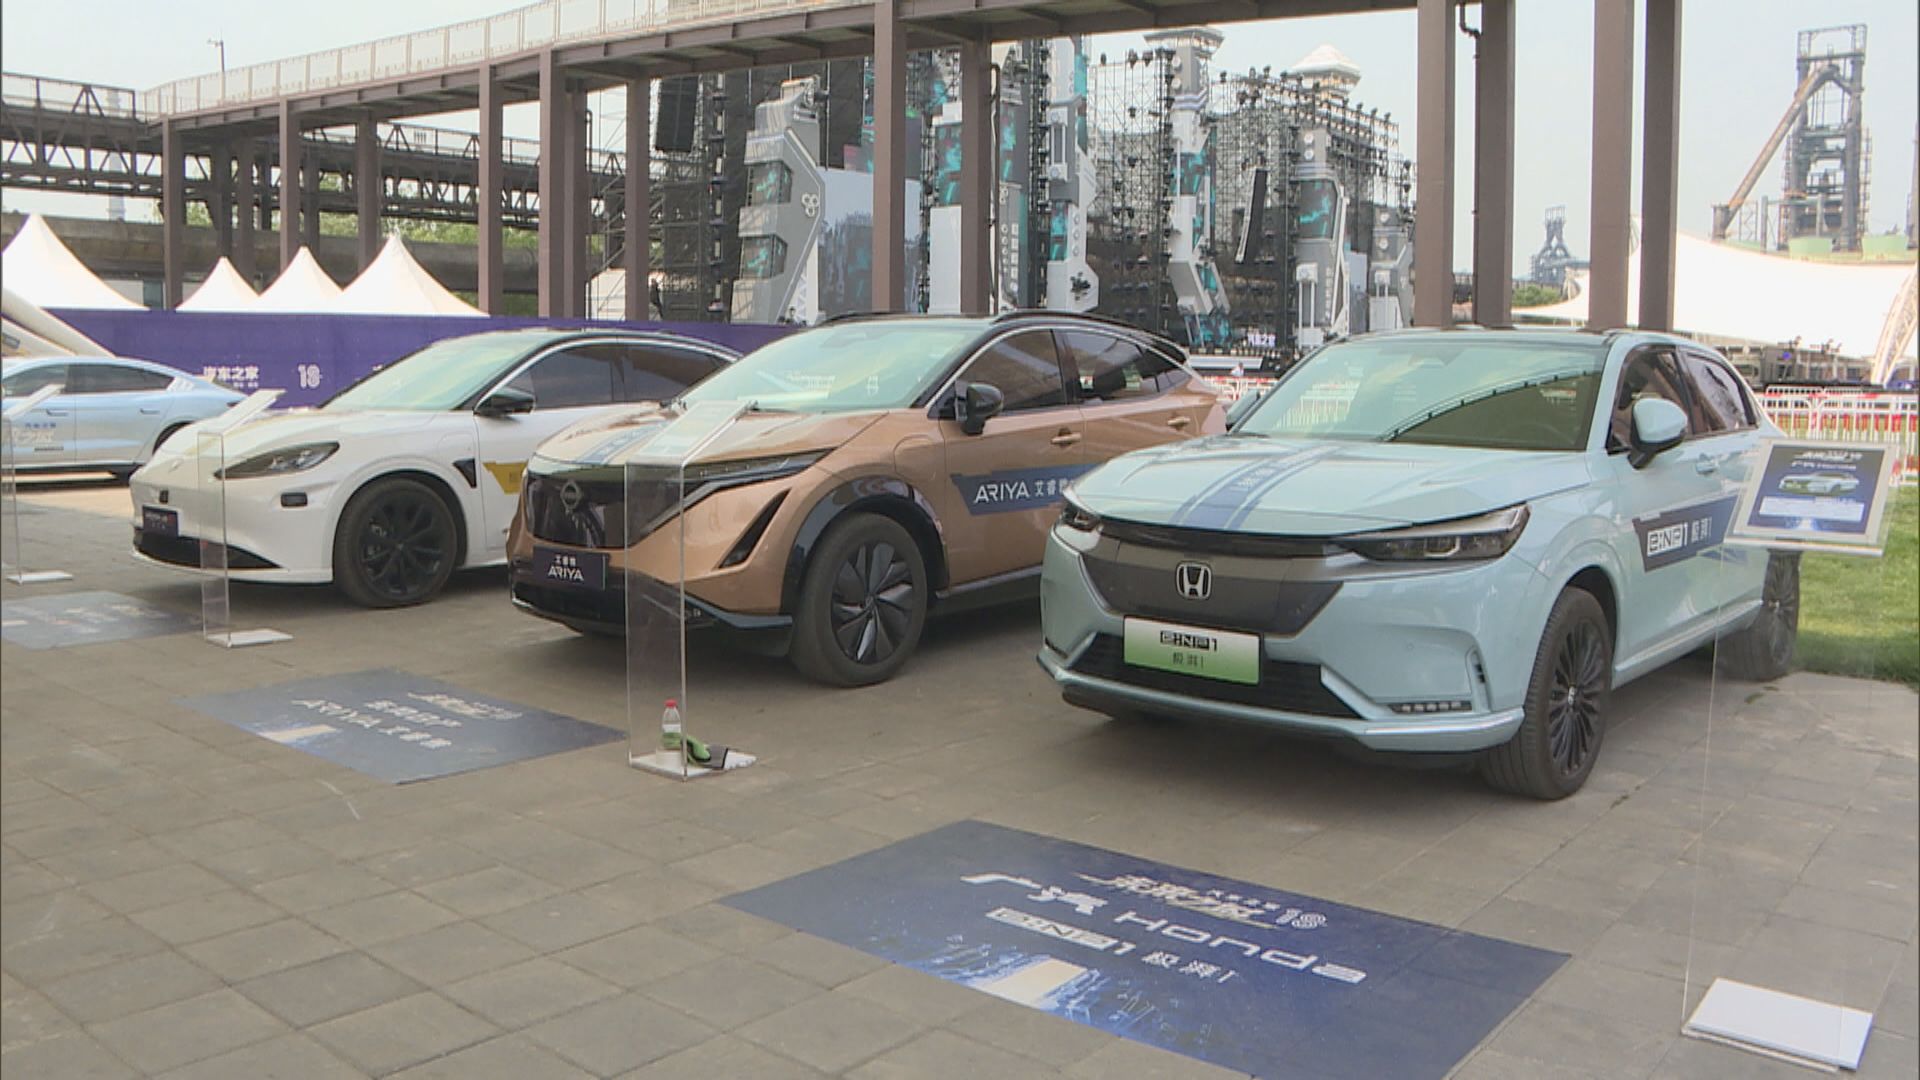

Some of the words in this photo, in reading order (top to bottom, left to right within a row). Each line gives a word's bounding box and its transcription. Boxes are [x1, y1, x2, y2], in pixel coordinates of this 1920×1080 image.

[973, 481, 1030, 504] ARIYA
[548, 565, 585, 581] ARIYA
[1113, 911, 1368, 985] Honda
